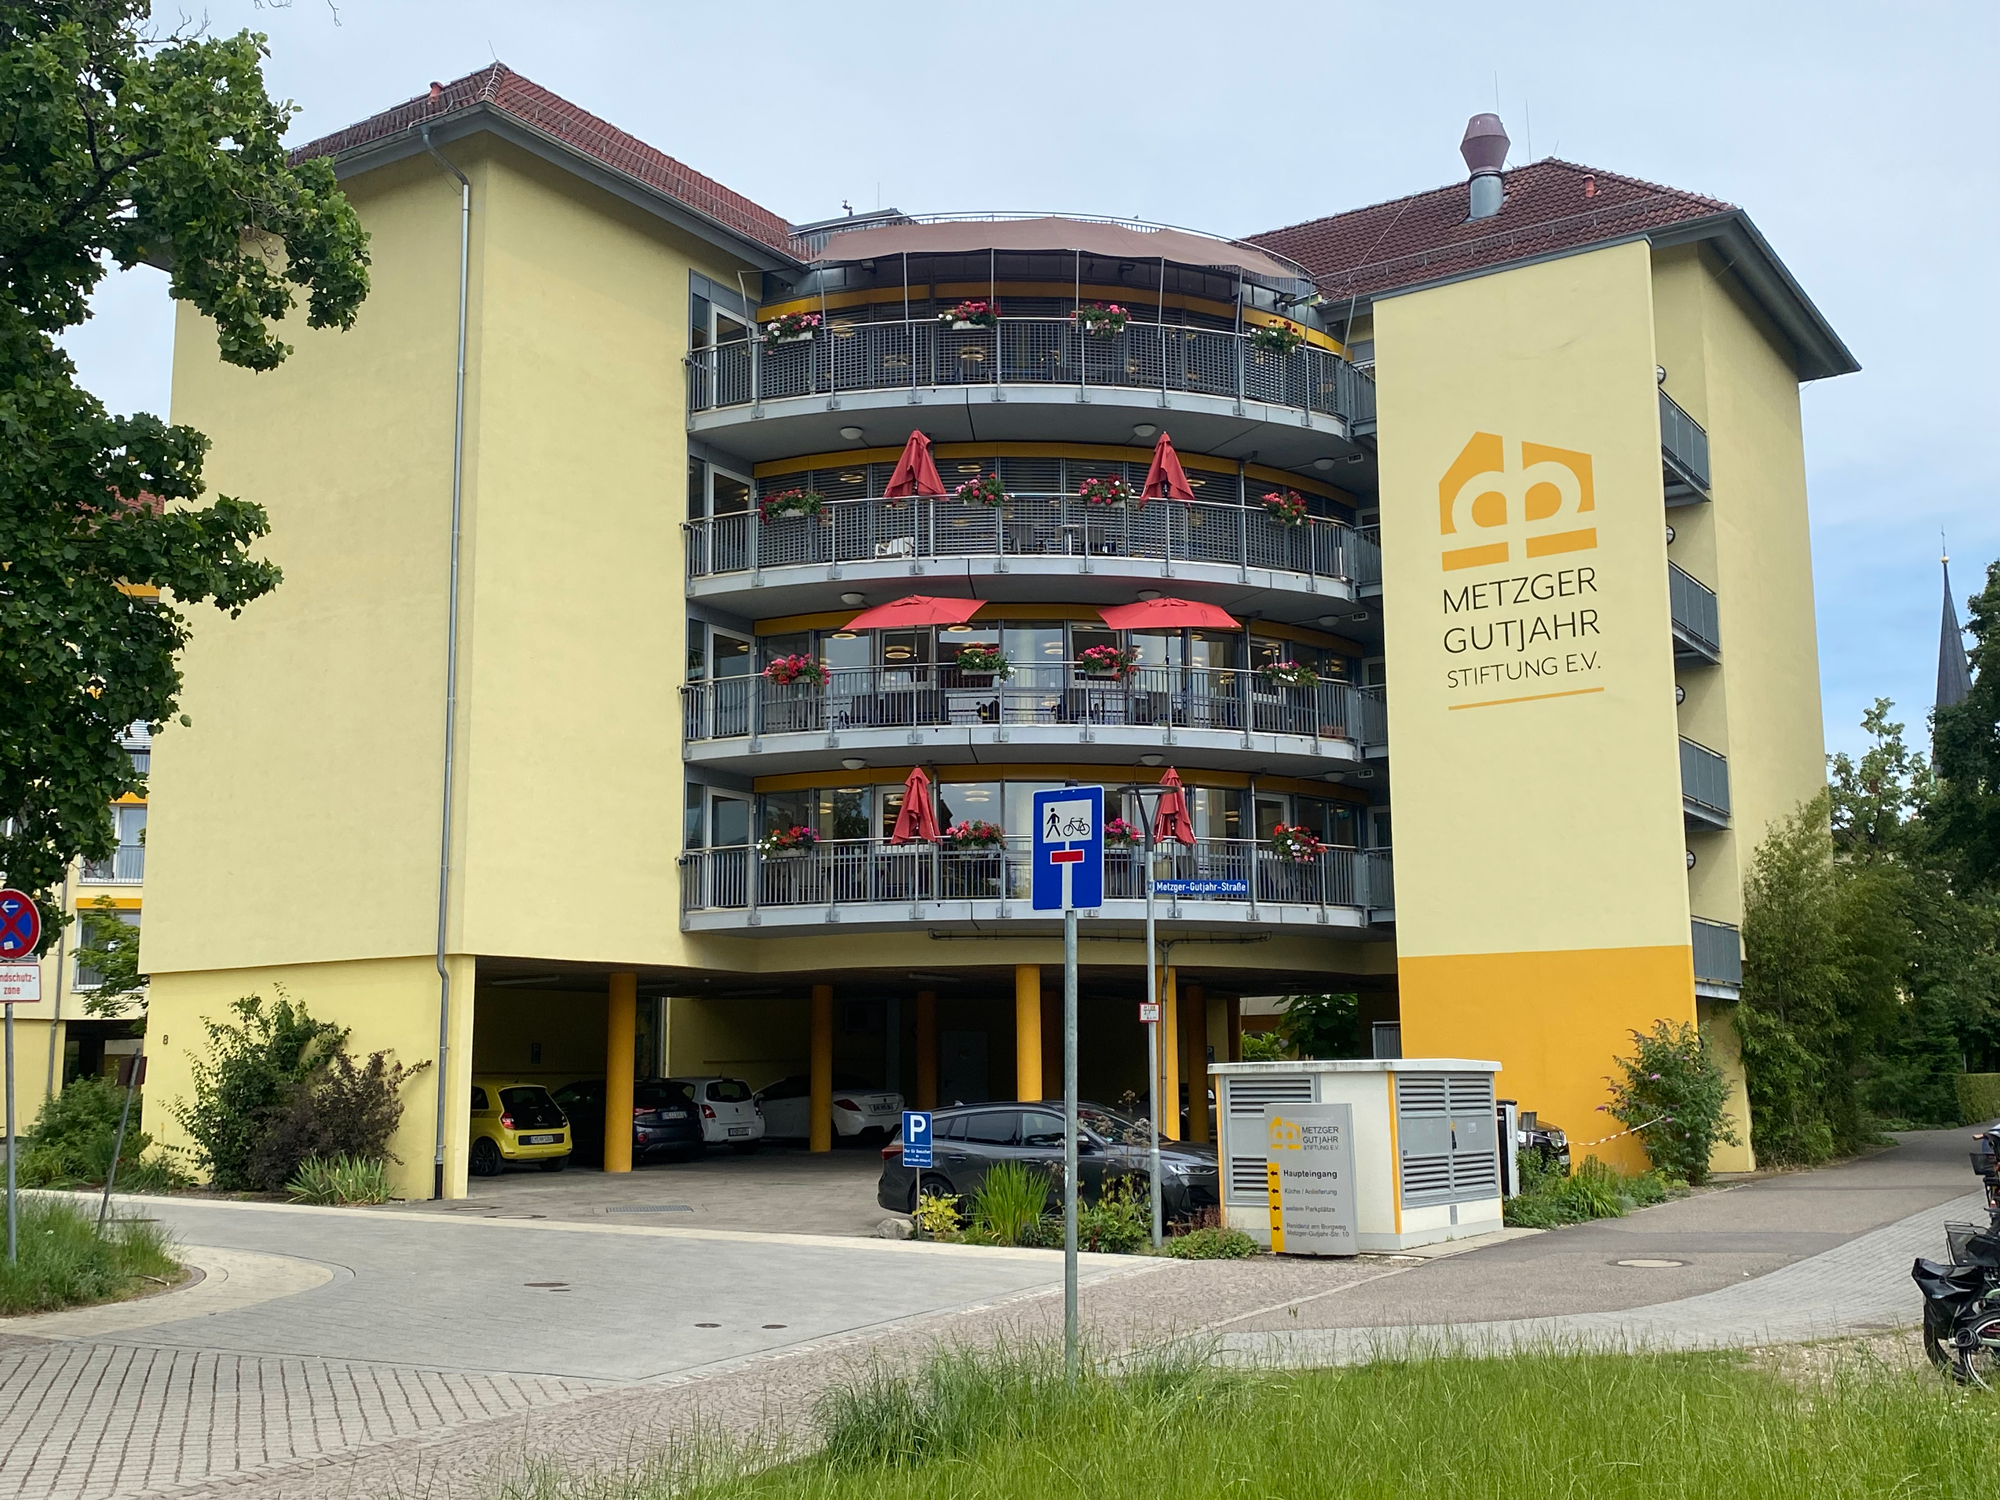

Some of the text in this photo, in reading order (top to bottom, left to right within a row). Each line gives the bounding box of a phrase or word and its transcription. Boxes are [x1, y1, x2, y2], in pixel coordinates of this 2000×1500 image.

[1443, 567, 1597, 614] METZGER
[1443, 609, 1600, 653] GUTJAHR
[1447, 651, 1601, 688] STIFTUNG E.V.
[1156, 881, 1246, 893] Metzger-Gutjahr-Straße
[3, 987, 21, 995] zone
[162, 1034, 169, 1045] 8
[910, 1115, 926, 1142] P
[1302, 1126, 1339, 1134] METZGER
[1302, 1136, 1339, 1145] GUTJAHR
[1283, 1169, 1338, 1179] Haupteingang
